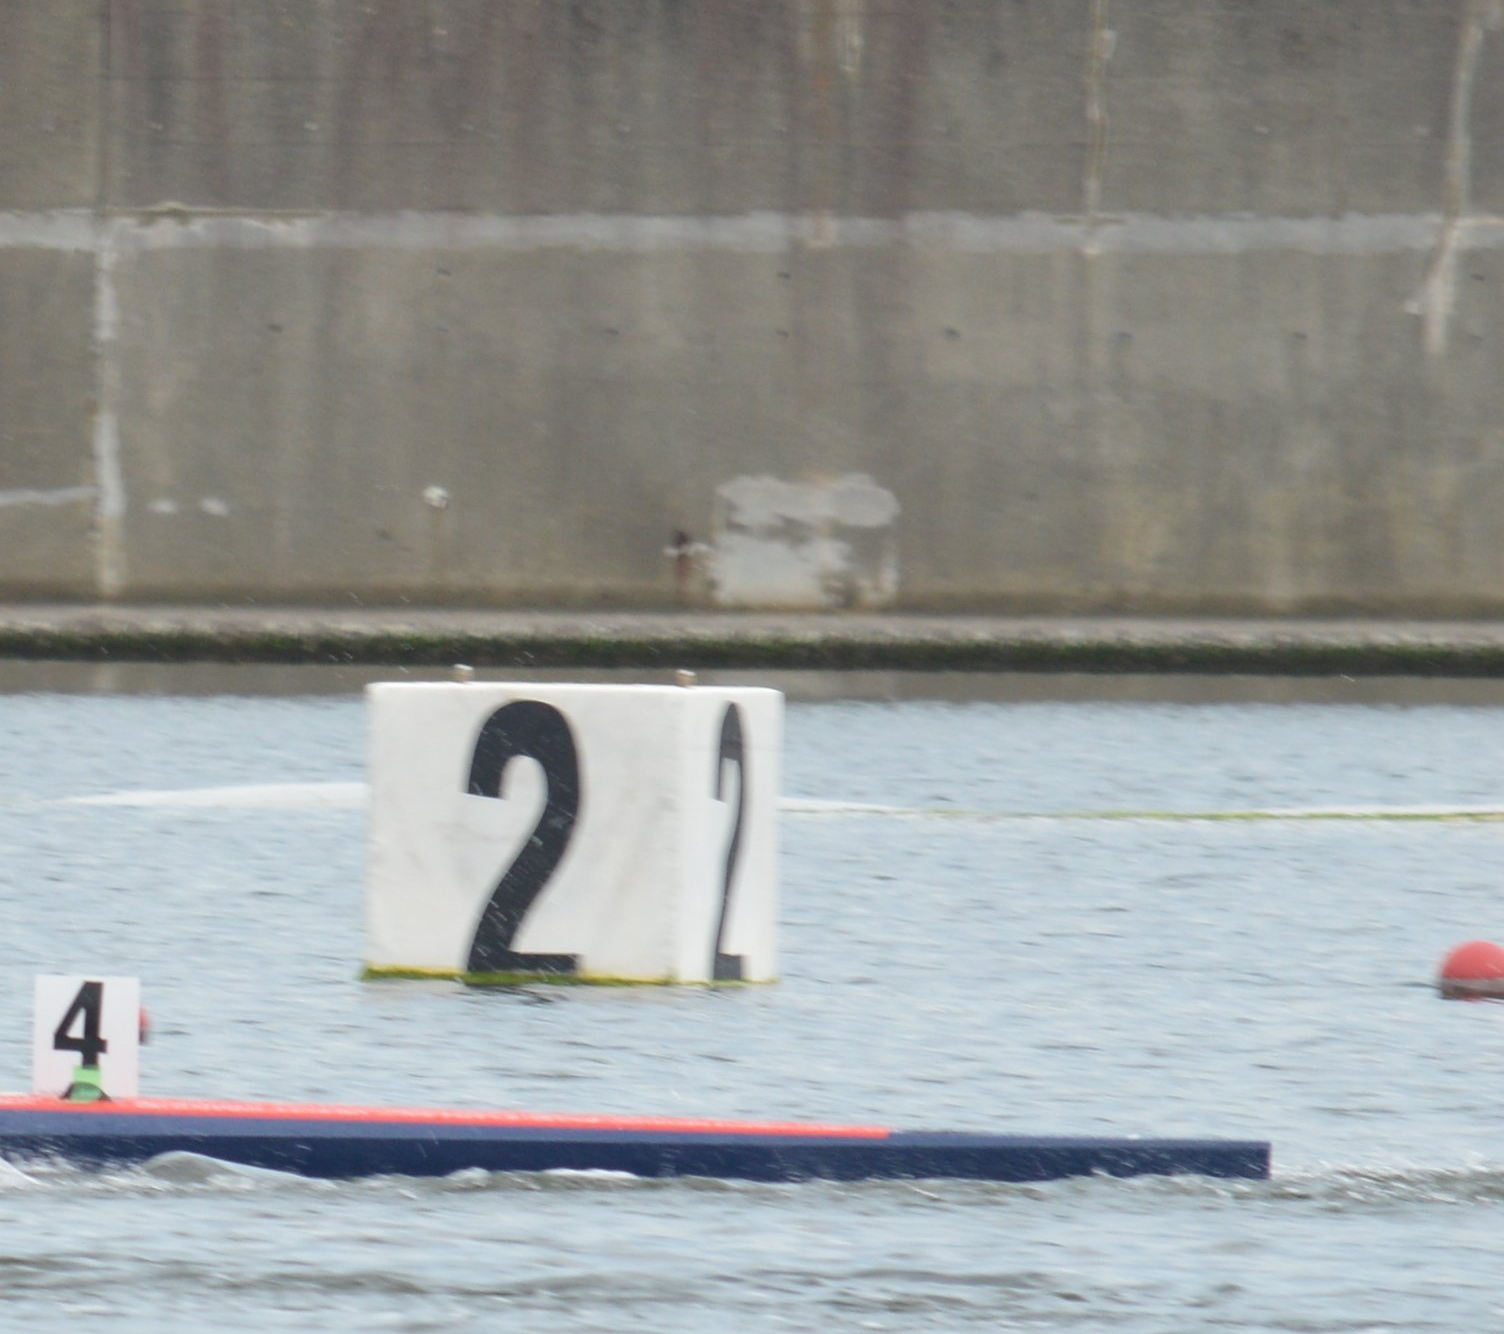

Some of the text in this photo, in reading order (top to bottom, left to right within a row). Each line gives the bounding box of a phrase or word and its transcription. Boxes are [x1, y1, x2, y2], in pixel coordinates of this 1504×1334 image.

[460, 699, 583, 974] 2
[712, 701, 746, 982] 2
[53, 981, 109, 1068] 4
